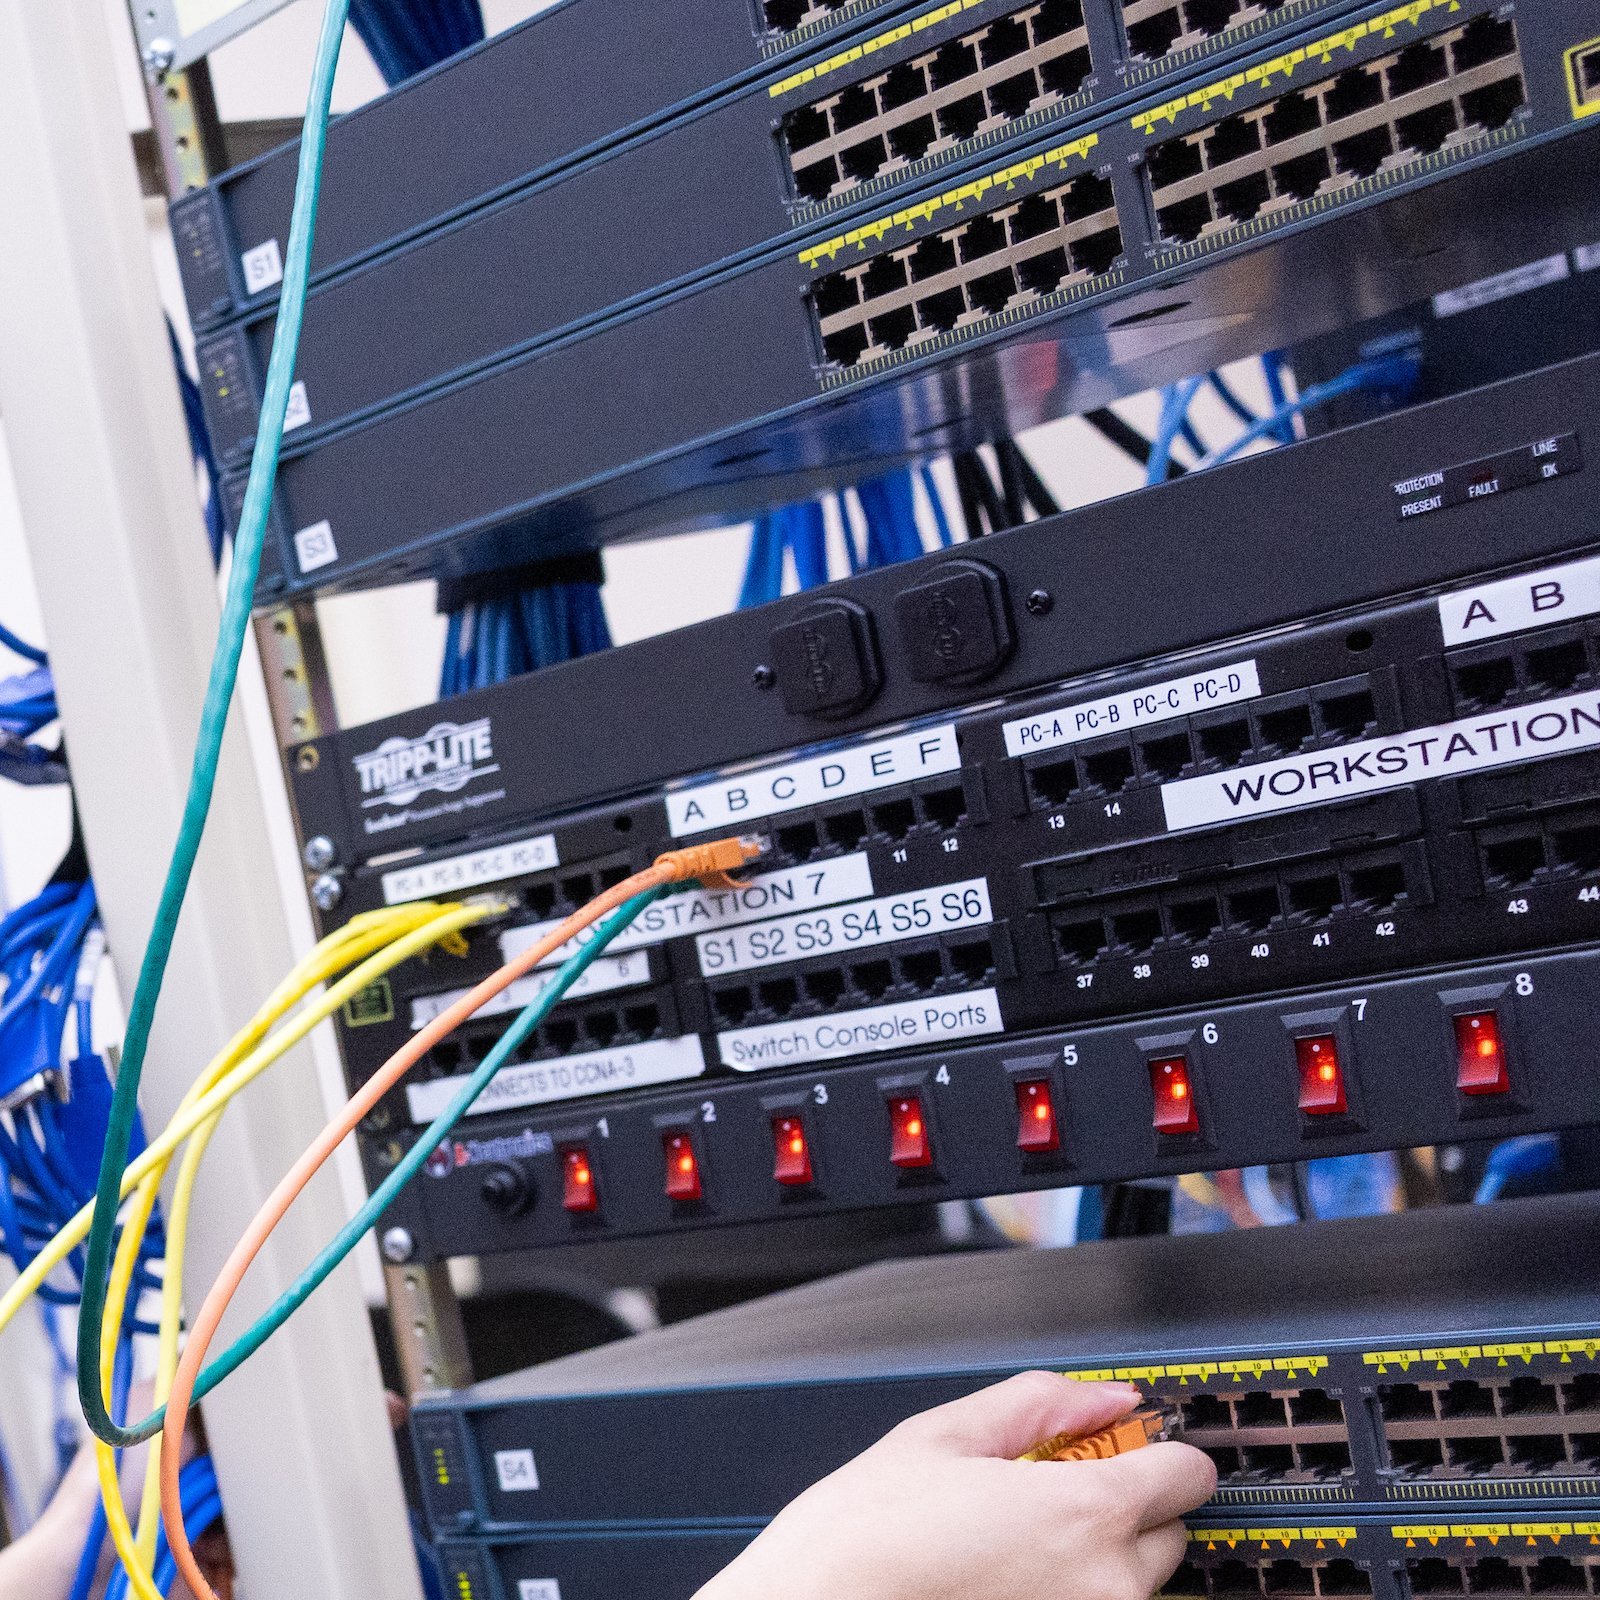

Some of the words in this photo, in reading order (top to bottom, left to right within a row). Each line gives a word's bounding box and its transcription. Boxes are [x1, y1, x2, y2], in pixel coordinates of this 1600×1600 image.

[251, 256, 275, 278] S1
[1532, 439, 1558, 457] LINE
[1468, 479, 1499, 498] FAULT
[1401, 495, 1442, 517] PRESENT
[304, 534, 327, 560] S3
[1462, 599, 1496, 630] A
[1530, 581, 1565, 613] B
[1020, 719, 1063, 745] PC-A
[1075, 704, 1120, 731] PC-B
[1133, 688, 1180, 717] PC-C
[1193, 673, 1241, 701] PC-D
[1221, 702, 1600, 806] WORKSTATION
[683, 800, 705, 823] A
[727, 788, 750, 812] B
[771, 776, 796, 800] C
[820, 764, 846, 788] D
[870, 750, 895, 776] E
[919, 737, 941, 765] F
[1047, 815, 1065, 830] 13
[1103, 802, 1121, 818] 14
[433, 865, 465, 884] PC-B
[472, 856, 504, 875] PC-C
[512, 846, 546, 866] PC-D
[892, 849, 907, 863] 11
[942, 838, 959, 853] 12
[806, 872, 826, 895] 7
[1507, 898, 1529, 916] 43
[1578, 885, 1600, 902] 44
[704, 935, 738, 969] S1
[749, 927, 787, 961] S2
[794, 917, 834, 951] S3
[842, 908, 881, 941] S4
[890, 898, 932, 932] S5
[941, 888, 982, 922] S6
[1076, 973, 1094, 990] 37
[1133, 963, 1152, 979] 38
[1190, 953, 1210, 970] 39
[1250, 943, 1270, 959] 40
[1312, 932, 1331, 948] 41
[1375, 921, 1396, 938] 42
[732, 1031, 811, 1064] Switch
[815, 1014, 917, 1051] Console
[924, 1003, 988, 1033] Ports
[597, 1118, 609, 1138] 1
[701, 1101, 717, 1124] 2
[814, 1083, 829, 1105] 3
[935, 1065, 951, 1087] 4
[1063, 1045, 1079, 1066] 5
[1202, 1022, 1219, 1045] 6
[1351, 998, 1368, 1022] 7
[1514, 972, 1534, 997] 8
[479, 1070, 545, 1099] ONNECTS
[550, 1067, 572, 1089] TO
[503, 1458, 528, 1481] S4
